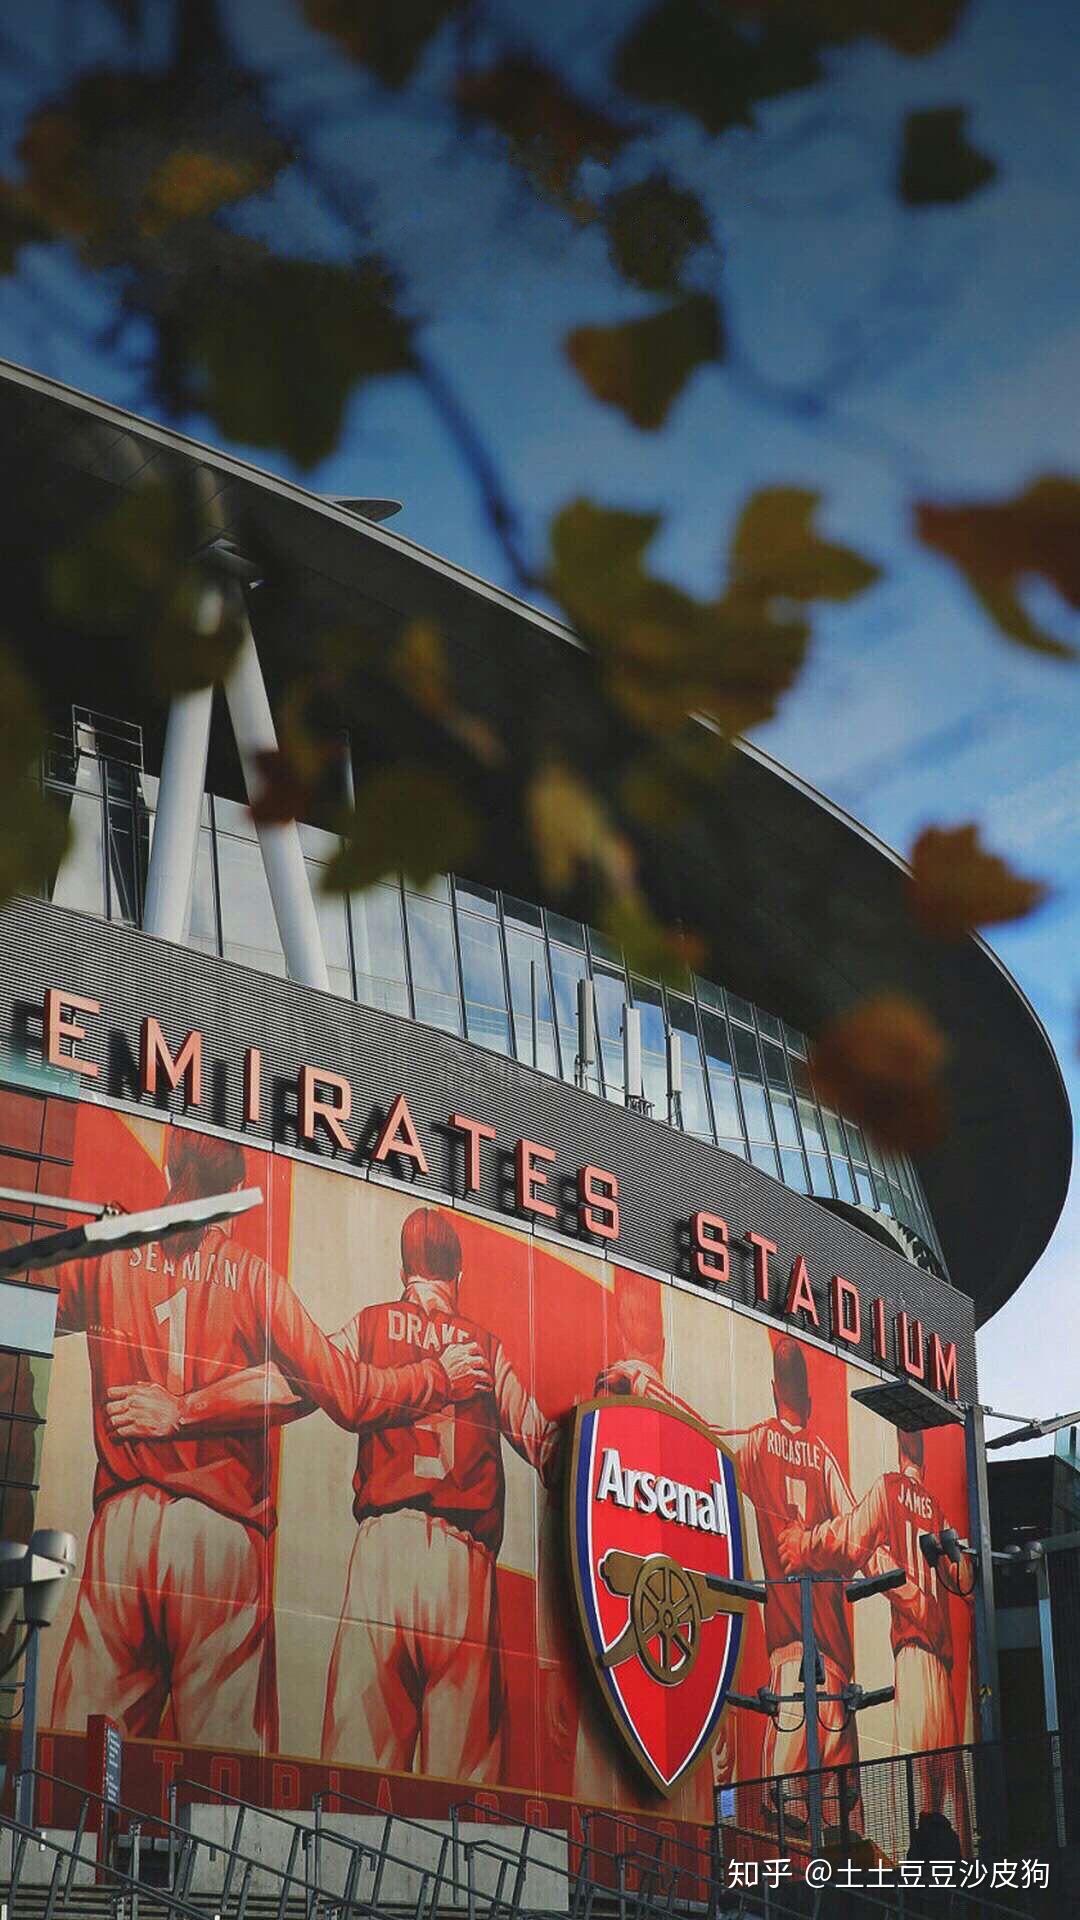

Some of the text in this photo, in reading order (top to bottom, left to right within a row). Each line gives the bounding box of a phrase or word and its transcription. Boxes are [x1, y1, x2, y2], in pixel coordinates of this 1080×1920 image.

[45, 988, 960, 1400] EMIRATES STADIUM
[154, 1287, 188, 1396] 1
[596, 1447, 728, 1536] Arsenal
[767, 1429, 821, 1471] ROCASTLE
[898, 1483, 933, 1519] JAMES
